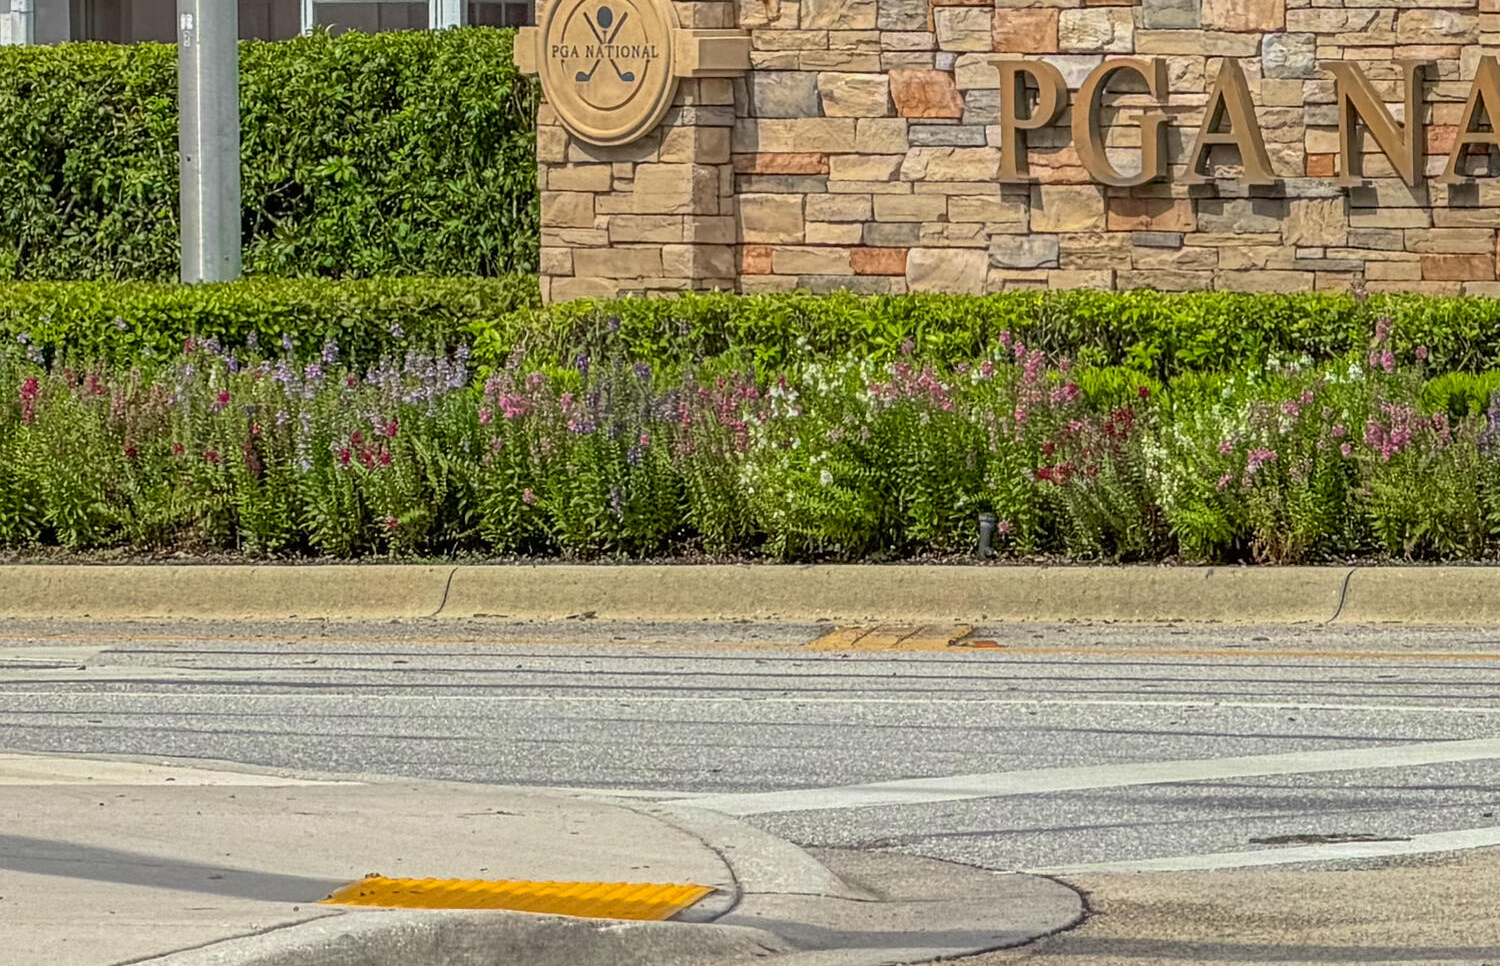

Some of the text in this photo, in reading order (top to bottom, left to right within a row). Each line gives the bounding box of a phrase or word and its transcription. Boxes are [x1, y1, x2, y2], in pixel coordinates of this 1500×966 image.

[551, 44, 659, 59] PGA NATIONAL
[988, 57, 1283, 188] PGA
